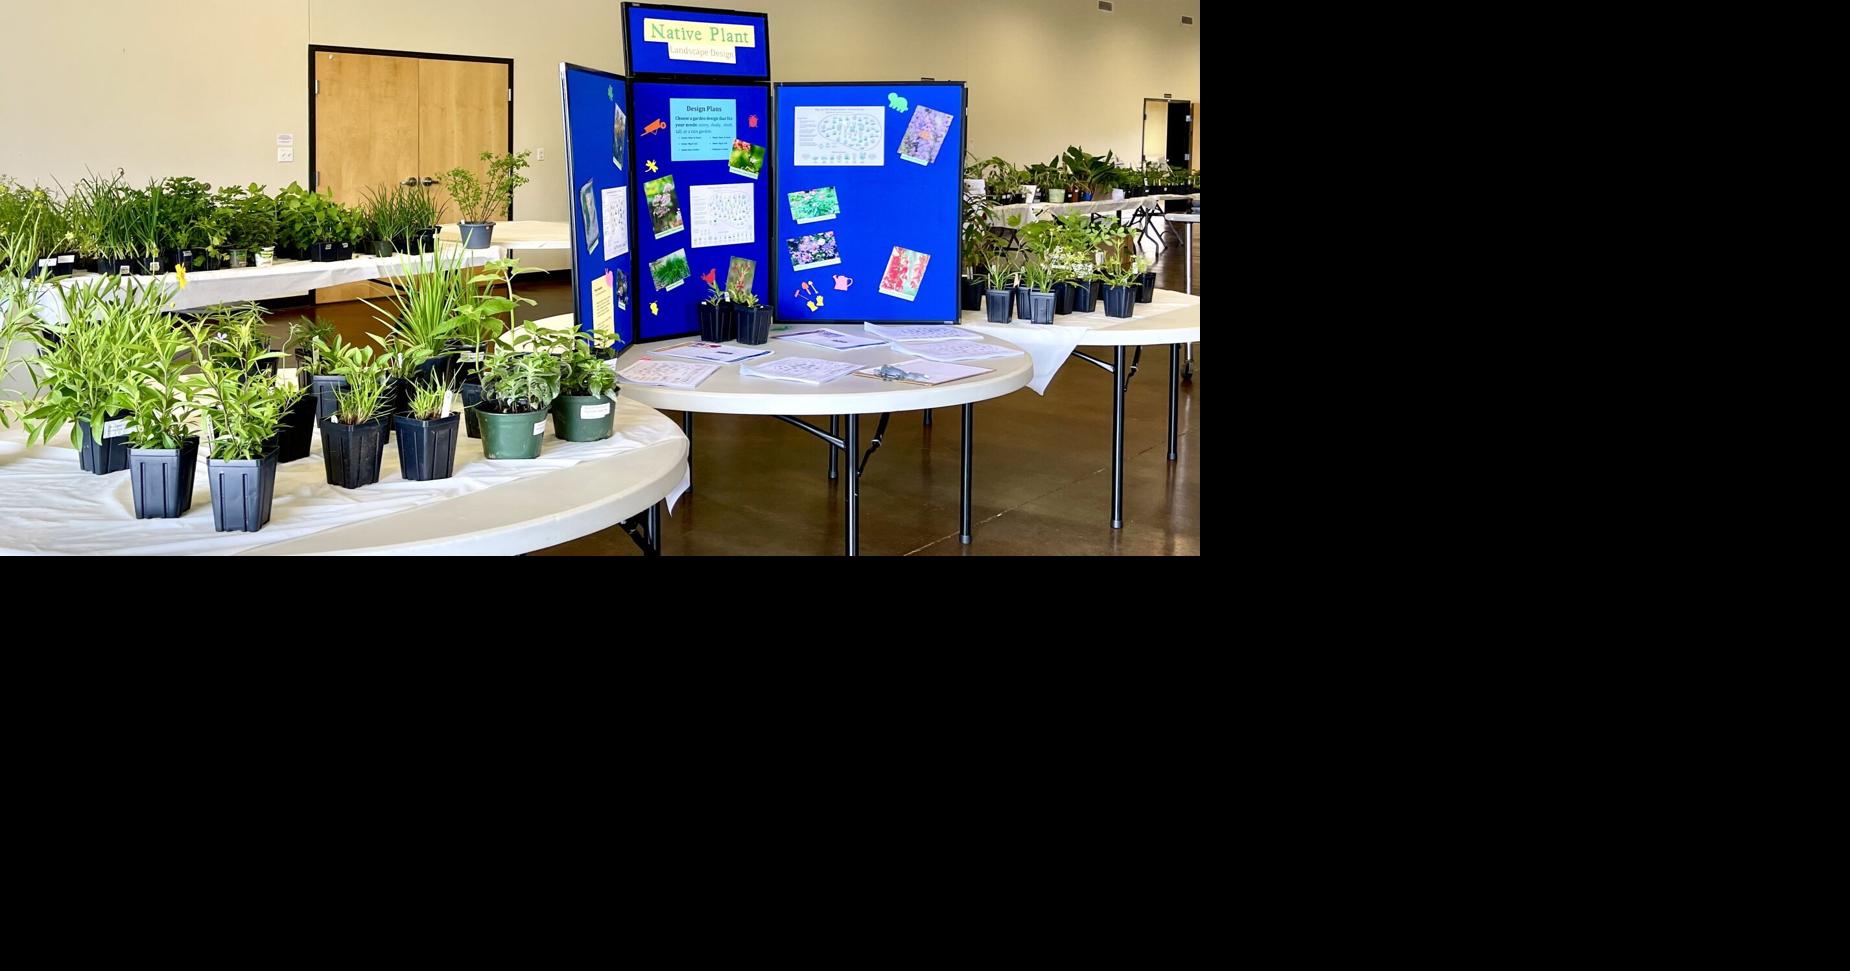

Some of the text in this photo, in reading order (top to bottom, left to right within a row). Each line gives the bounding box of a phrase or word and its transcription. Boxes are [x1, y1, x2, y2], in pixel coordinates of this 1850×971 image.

[651, 23, 749, 43] Native Plant
[670, 46, 734, 60] Landscape Design
